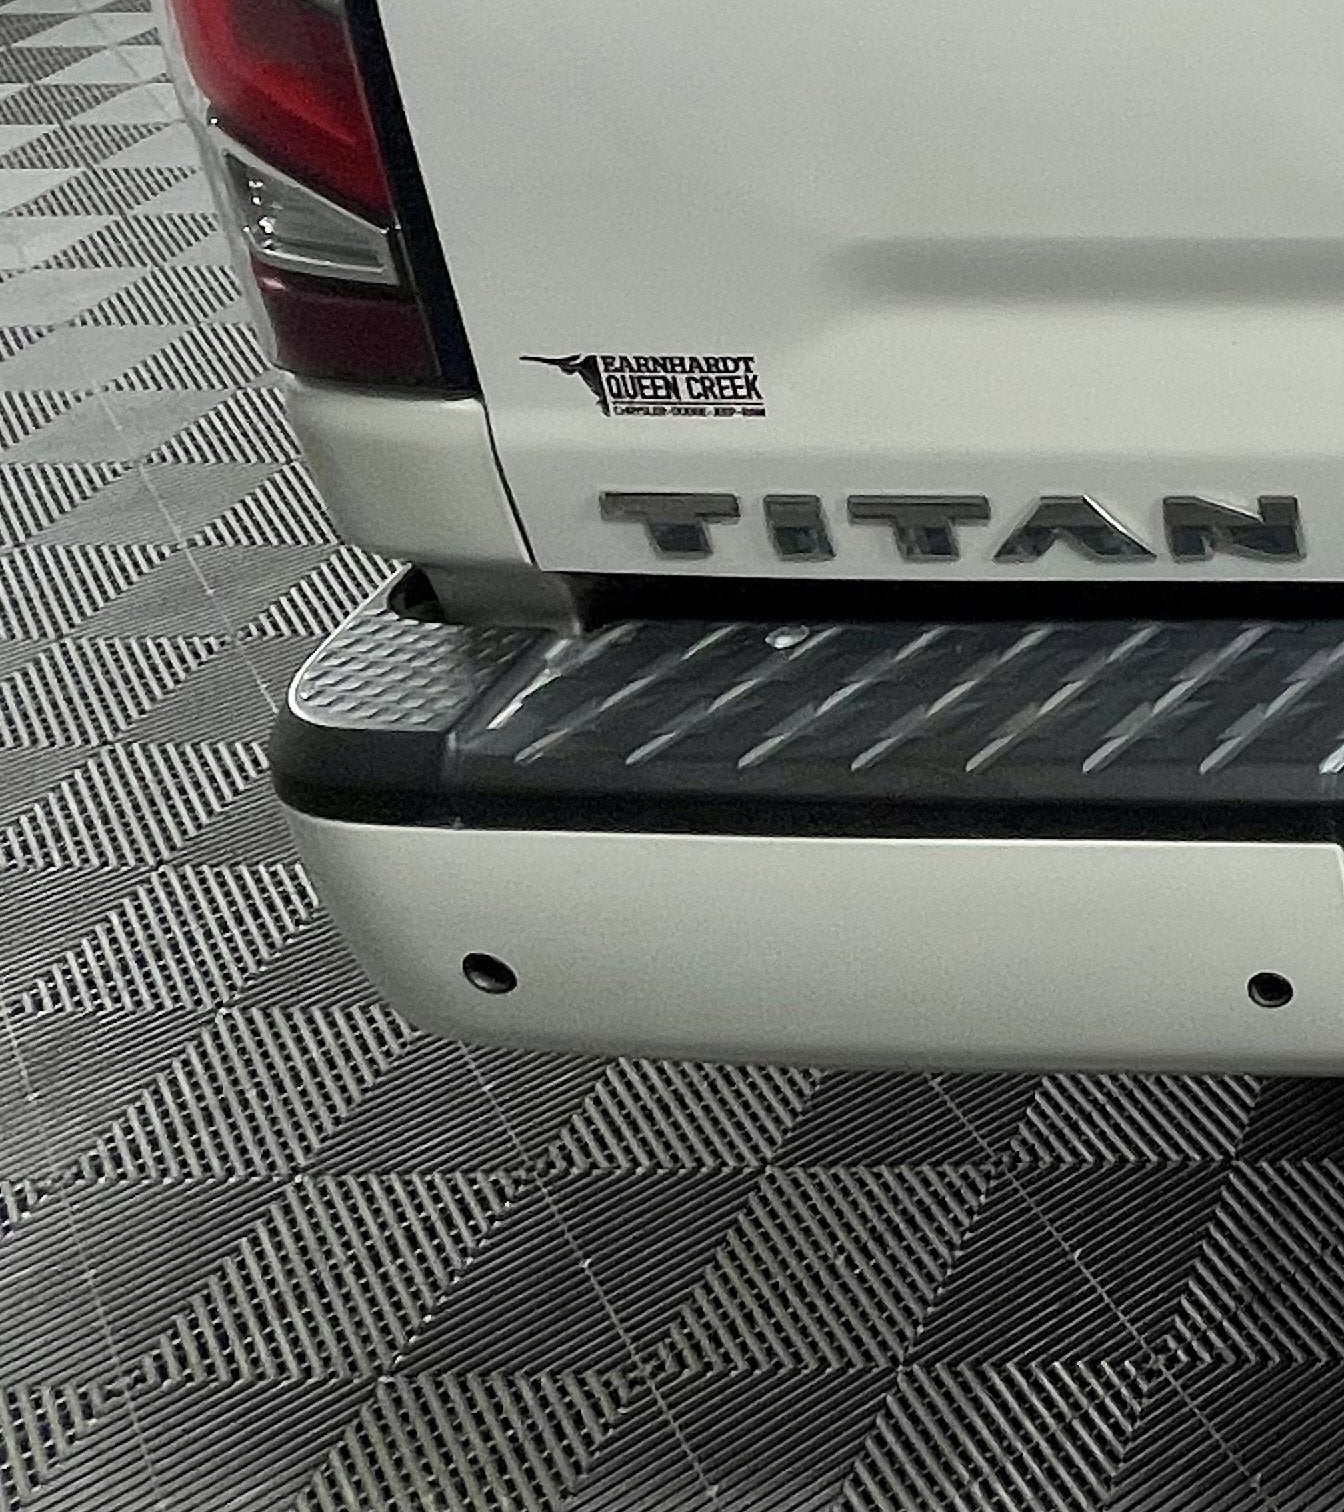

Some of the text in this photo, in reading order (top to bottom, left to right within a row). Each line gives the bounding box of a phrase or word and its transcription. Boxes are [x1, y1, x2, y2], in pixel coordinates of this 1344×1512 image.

[602, 356, 755, 374] EARNHARDT
[607, 375, 763, 400] QUEEN CREEK
[597, 491, 1308, 562] TITAN
